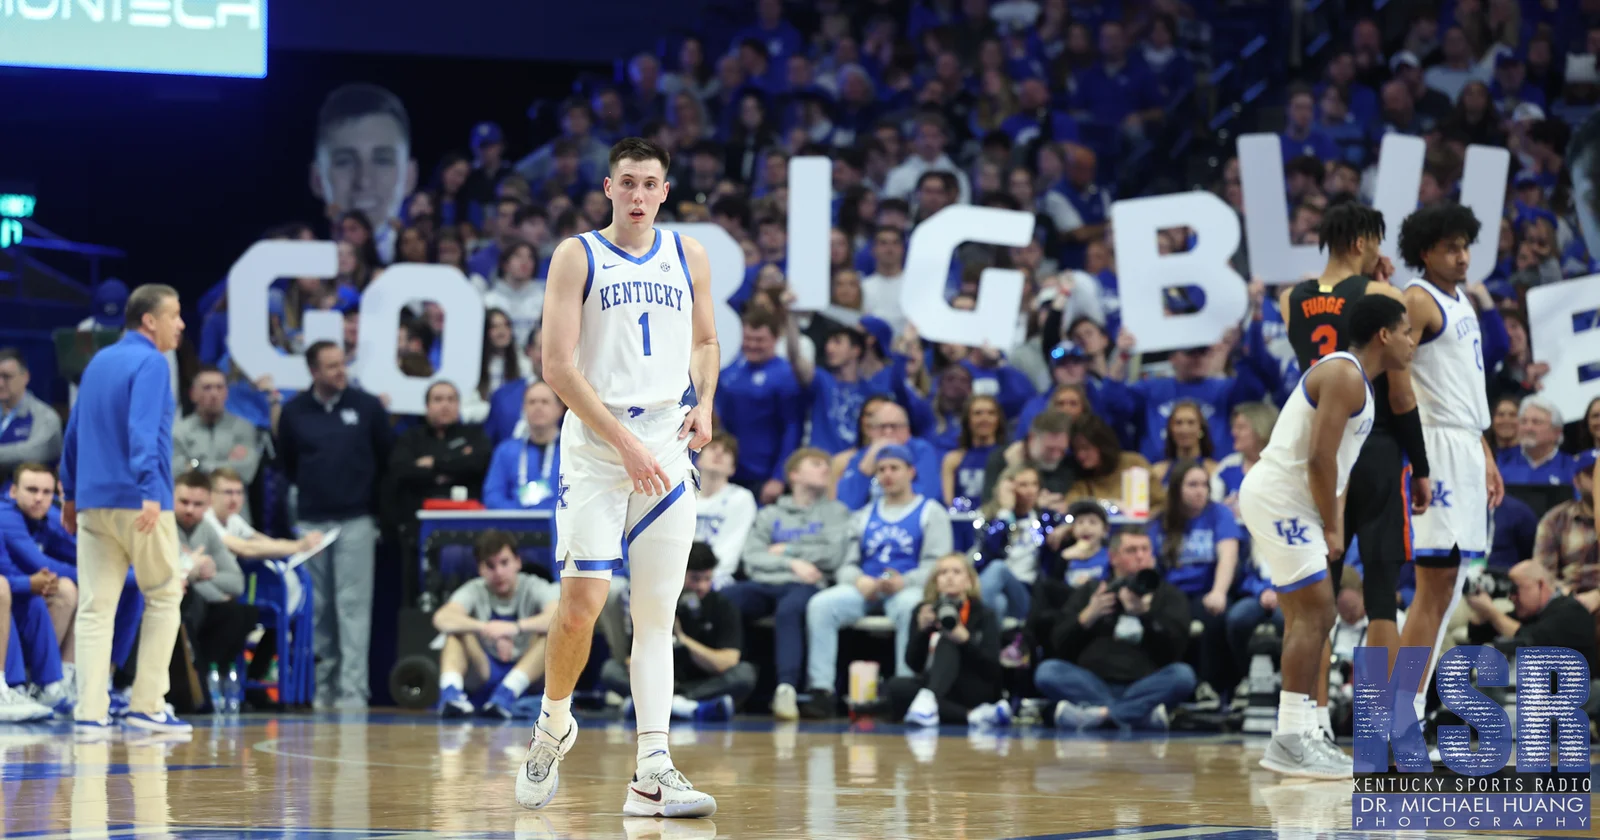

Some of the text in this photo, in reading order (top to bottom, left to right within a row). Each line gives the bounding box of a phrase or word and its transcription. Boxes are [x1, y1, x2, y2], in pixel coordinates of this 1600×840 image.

[600, 281, 683, 312] KENTUCKY
[1301, 296, 1346, 319] FUDGE
[638, 312, 652, 356] 1
[1310, 324, 1338, 366] 3
[1273, 516, 1312, 546] UK
